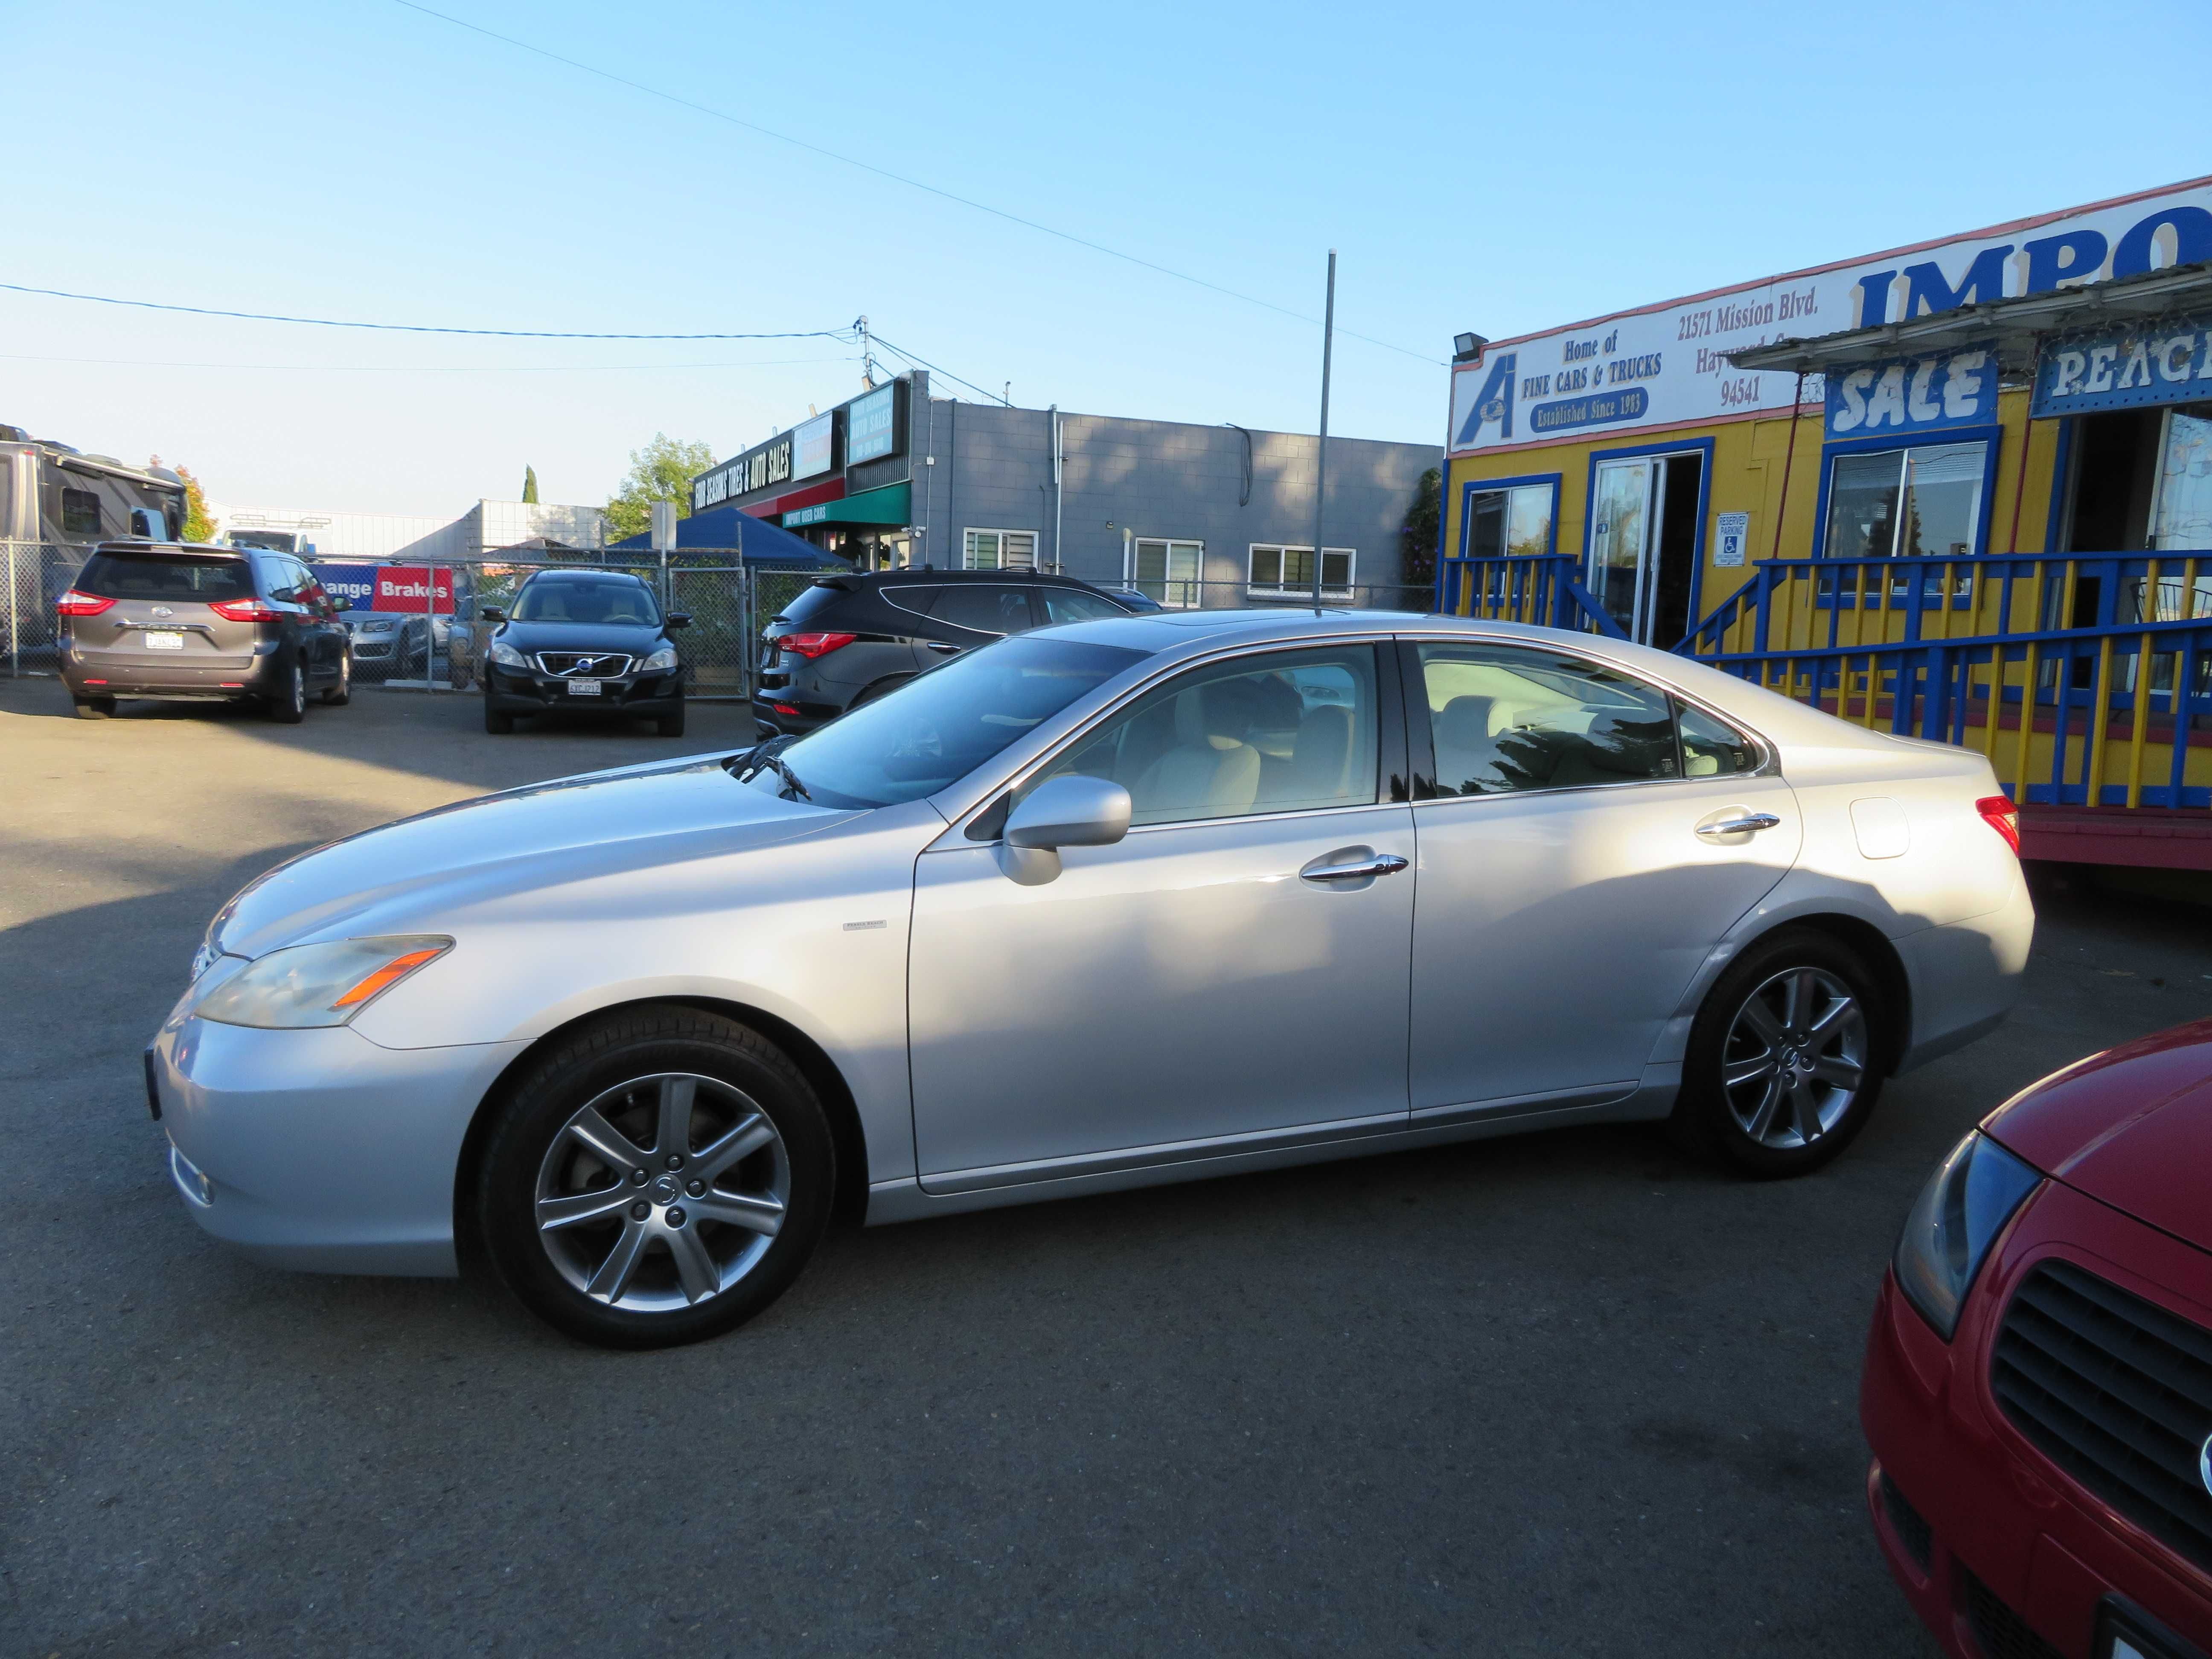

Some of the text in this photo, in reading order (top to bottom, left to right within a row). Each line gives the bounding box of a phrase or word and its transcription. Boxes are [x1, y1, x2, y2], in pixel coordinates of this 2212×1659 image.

[1678, 285, 1818, 341] 21571 Mission Blvd.
[1563, 329, 1618, 363] Home of
[1522, 352, 1662, 399] FINE CARS & TRUCKS
[1721, 375, 1760, 407] 94541
[1833, 351, 1986, 432] SALE
[851, 417, 867, 440] AUTO
[870, 407, 891, 433] SALES
[1537, 393, 1641, 427] Established Since 1983
[707, 470, 727, 506] SEASONS
[728, 463, 743, 498] TIRES
[745, 460, 749, 492] &
[751, 452, 766, 490] AUTO
[768, 441, 789, 484] SALES
[802, 509, 812, 523] USED
[814, 506, 826, 520] CARS
[1720, 515, 1746, 525] RESERVED
[1720, 526, 1743, 535] PARKING
[381, 581, 447, 598] Brakes
